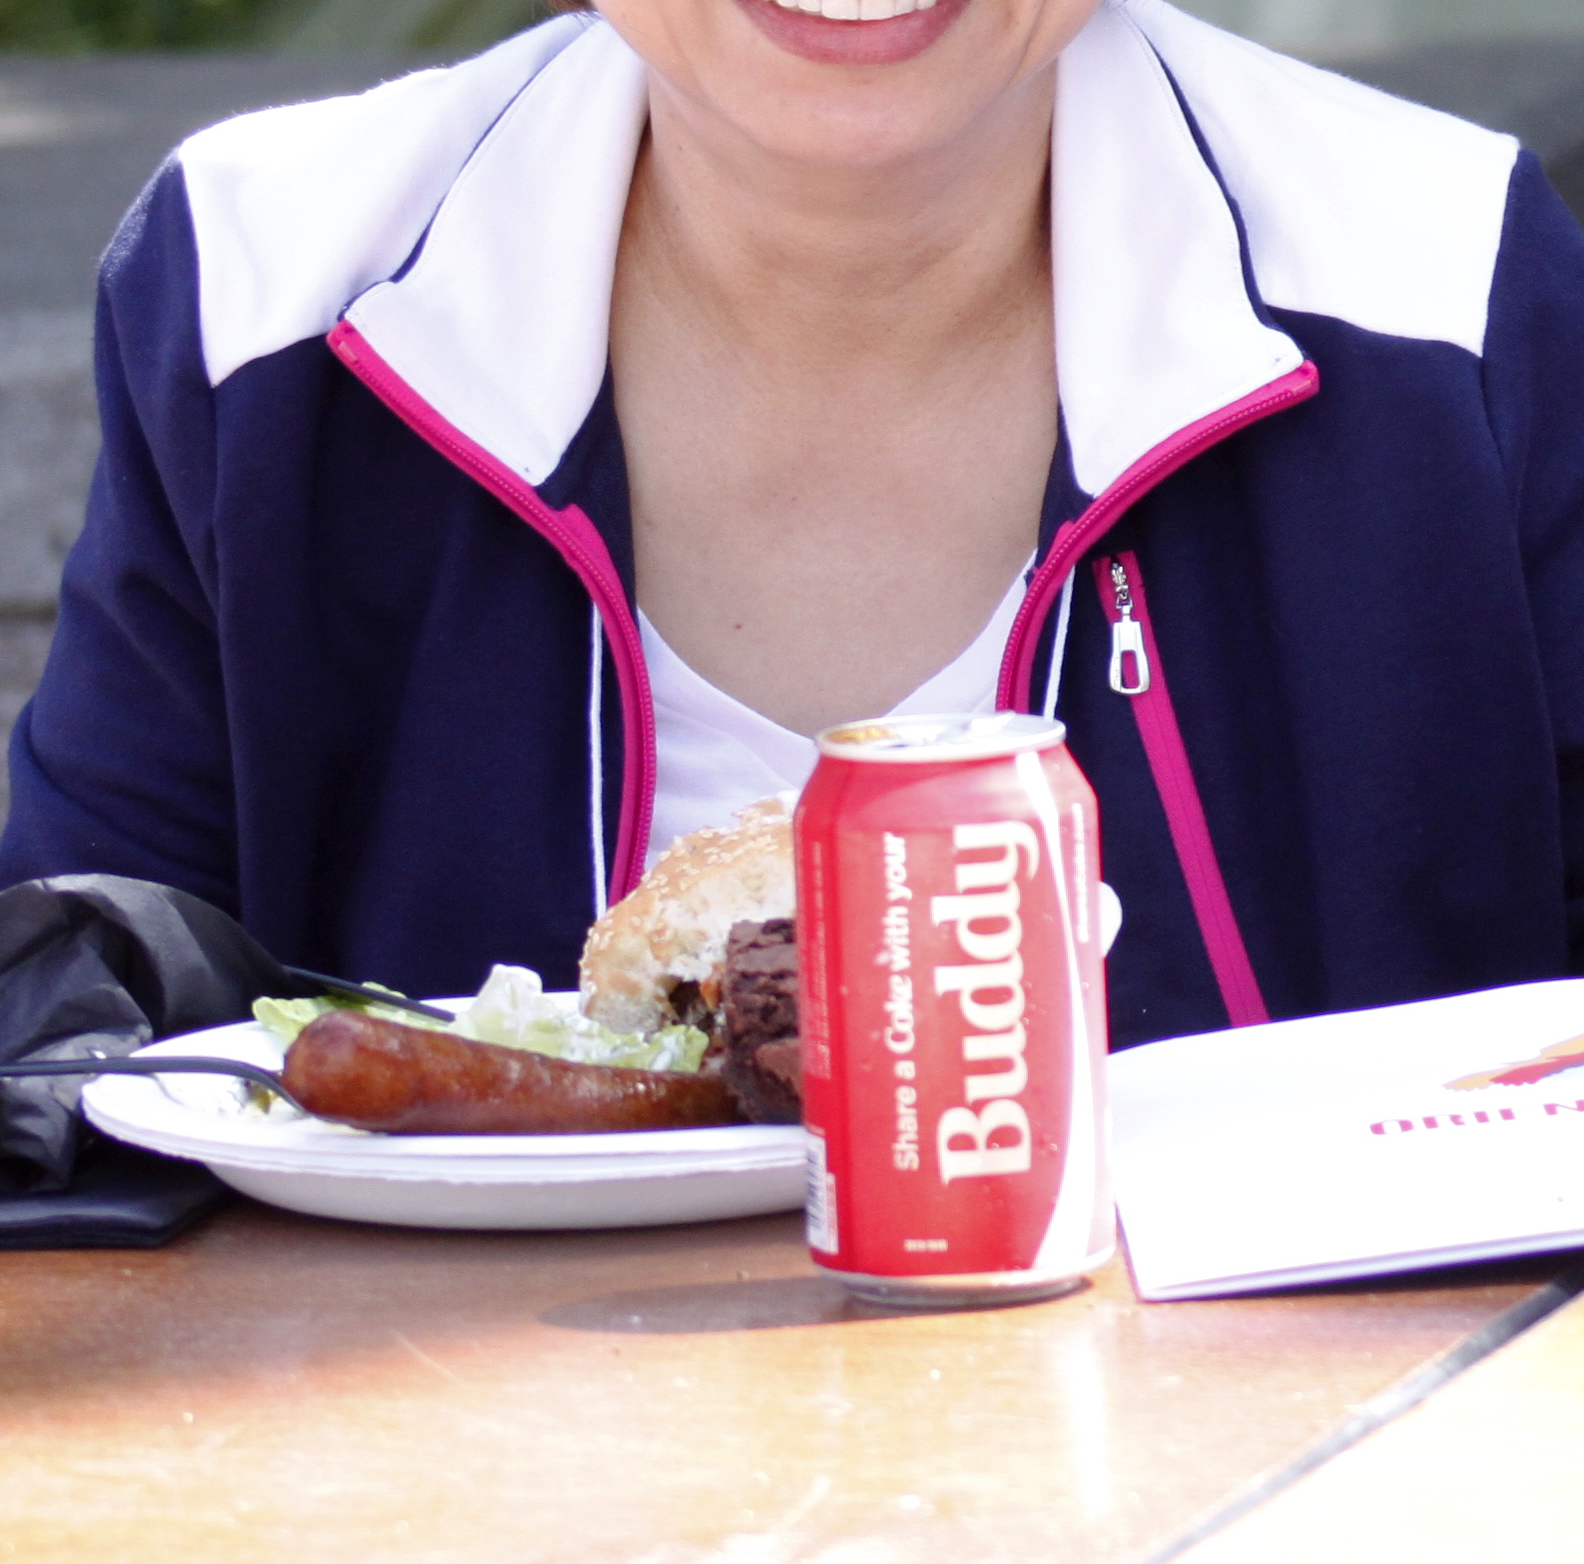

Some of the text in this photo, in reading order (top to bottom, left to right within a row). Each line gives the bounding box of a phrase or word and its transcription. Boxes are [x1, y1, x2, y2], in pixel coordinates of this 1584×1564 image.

[883, 831, 919, 1171] Share a Coke with your
[931, 820, 1040, 1187] Buddy
